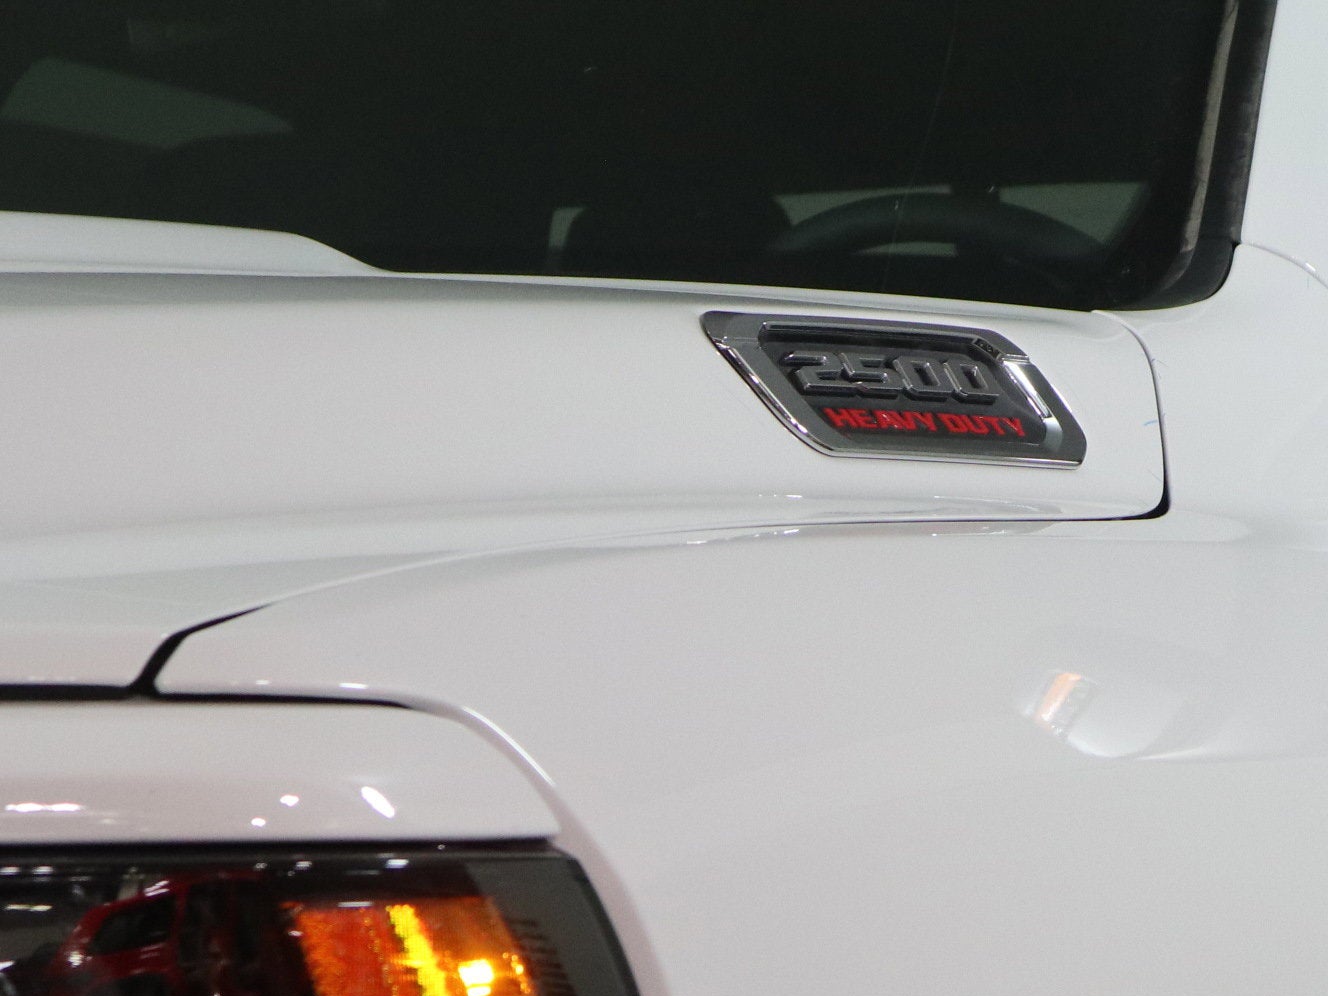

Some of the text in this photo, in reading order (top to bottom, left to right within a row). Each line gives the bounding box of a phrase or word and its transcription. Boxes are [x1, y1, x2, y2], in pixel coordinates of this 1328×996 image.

[783, 350, 1000, 401] 2500
[824, 408, 1025, 437] HEAVY DUTY
